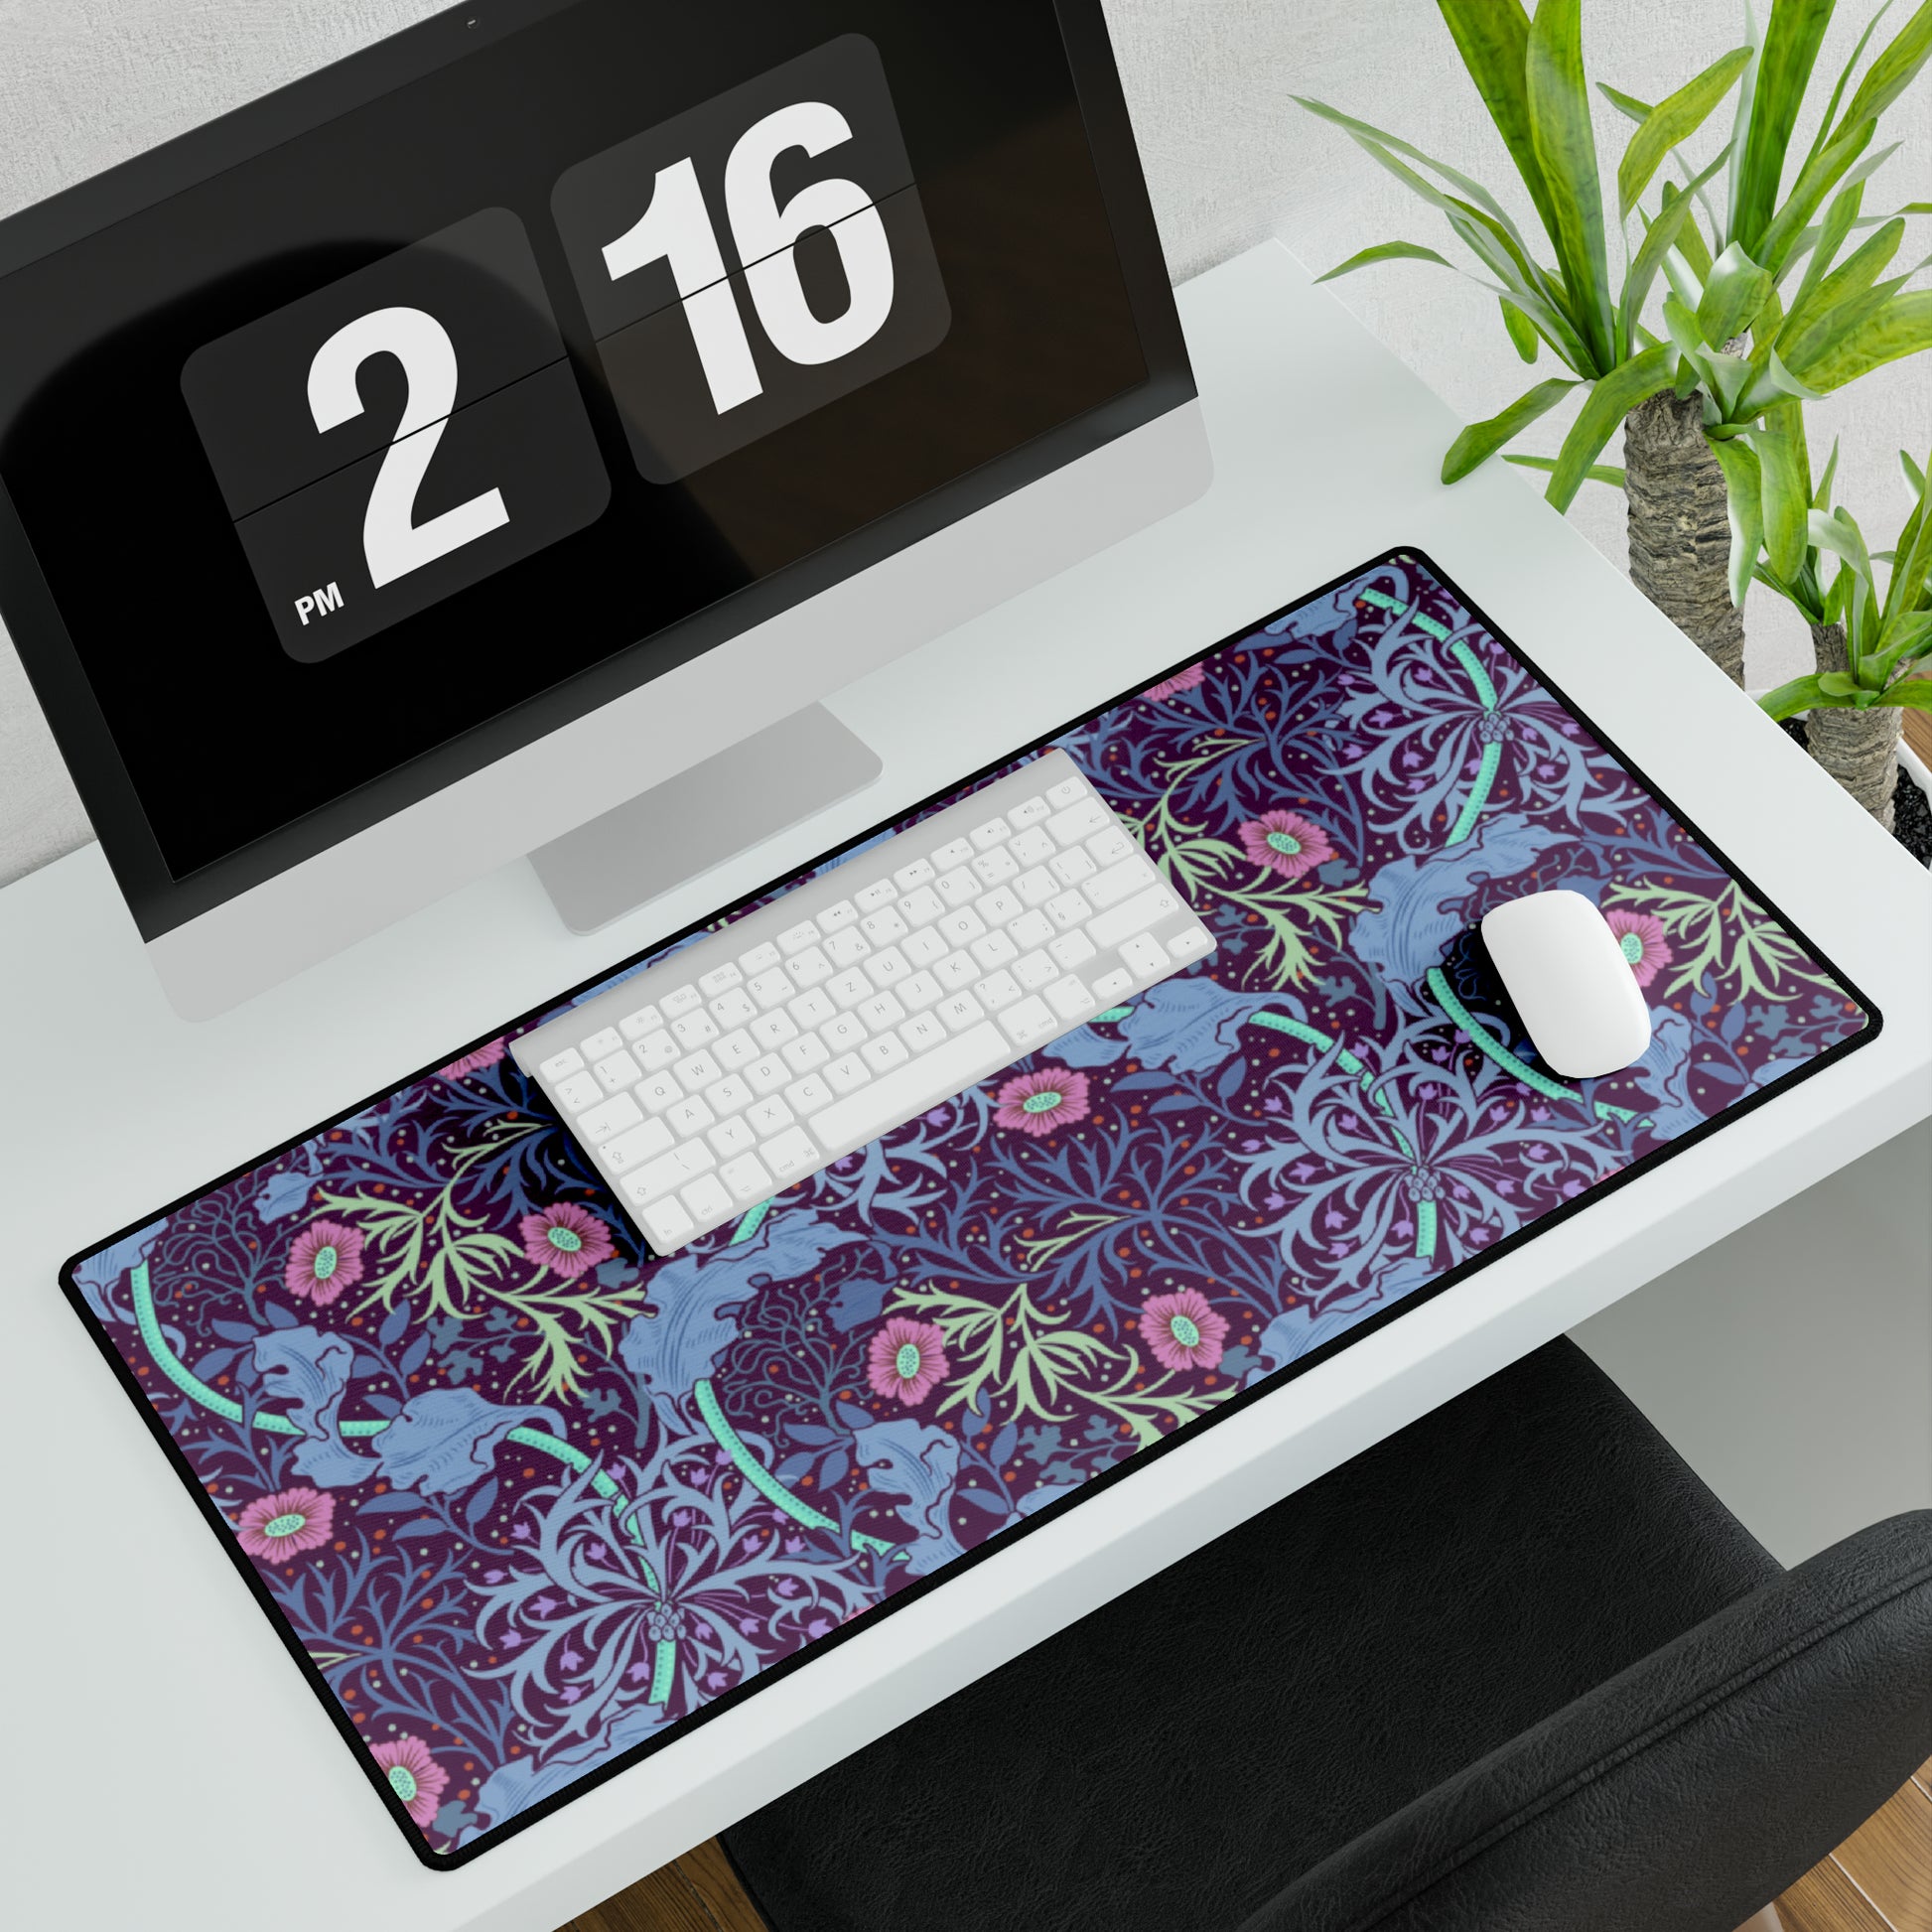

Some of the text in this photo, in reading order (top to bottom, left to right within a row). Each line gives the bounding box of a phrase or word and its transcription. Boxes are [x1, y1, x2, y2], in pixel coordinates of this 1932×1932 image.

[307, 101, 895, 590] 2 16
[294, 581, 345, 626] PM
[654, 900, 1004, 1097] Q W E R T Z U I O P
[684, 942, 999, 1120] A S D F G H J K L
[724, 1002, 968, 1140] Y X C V B N M
[779, 1160, 795, 1173] cmd
